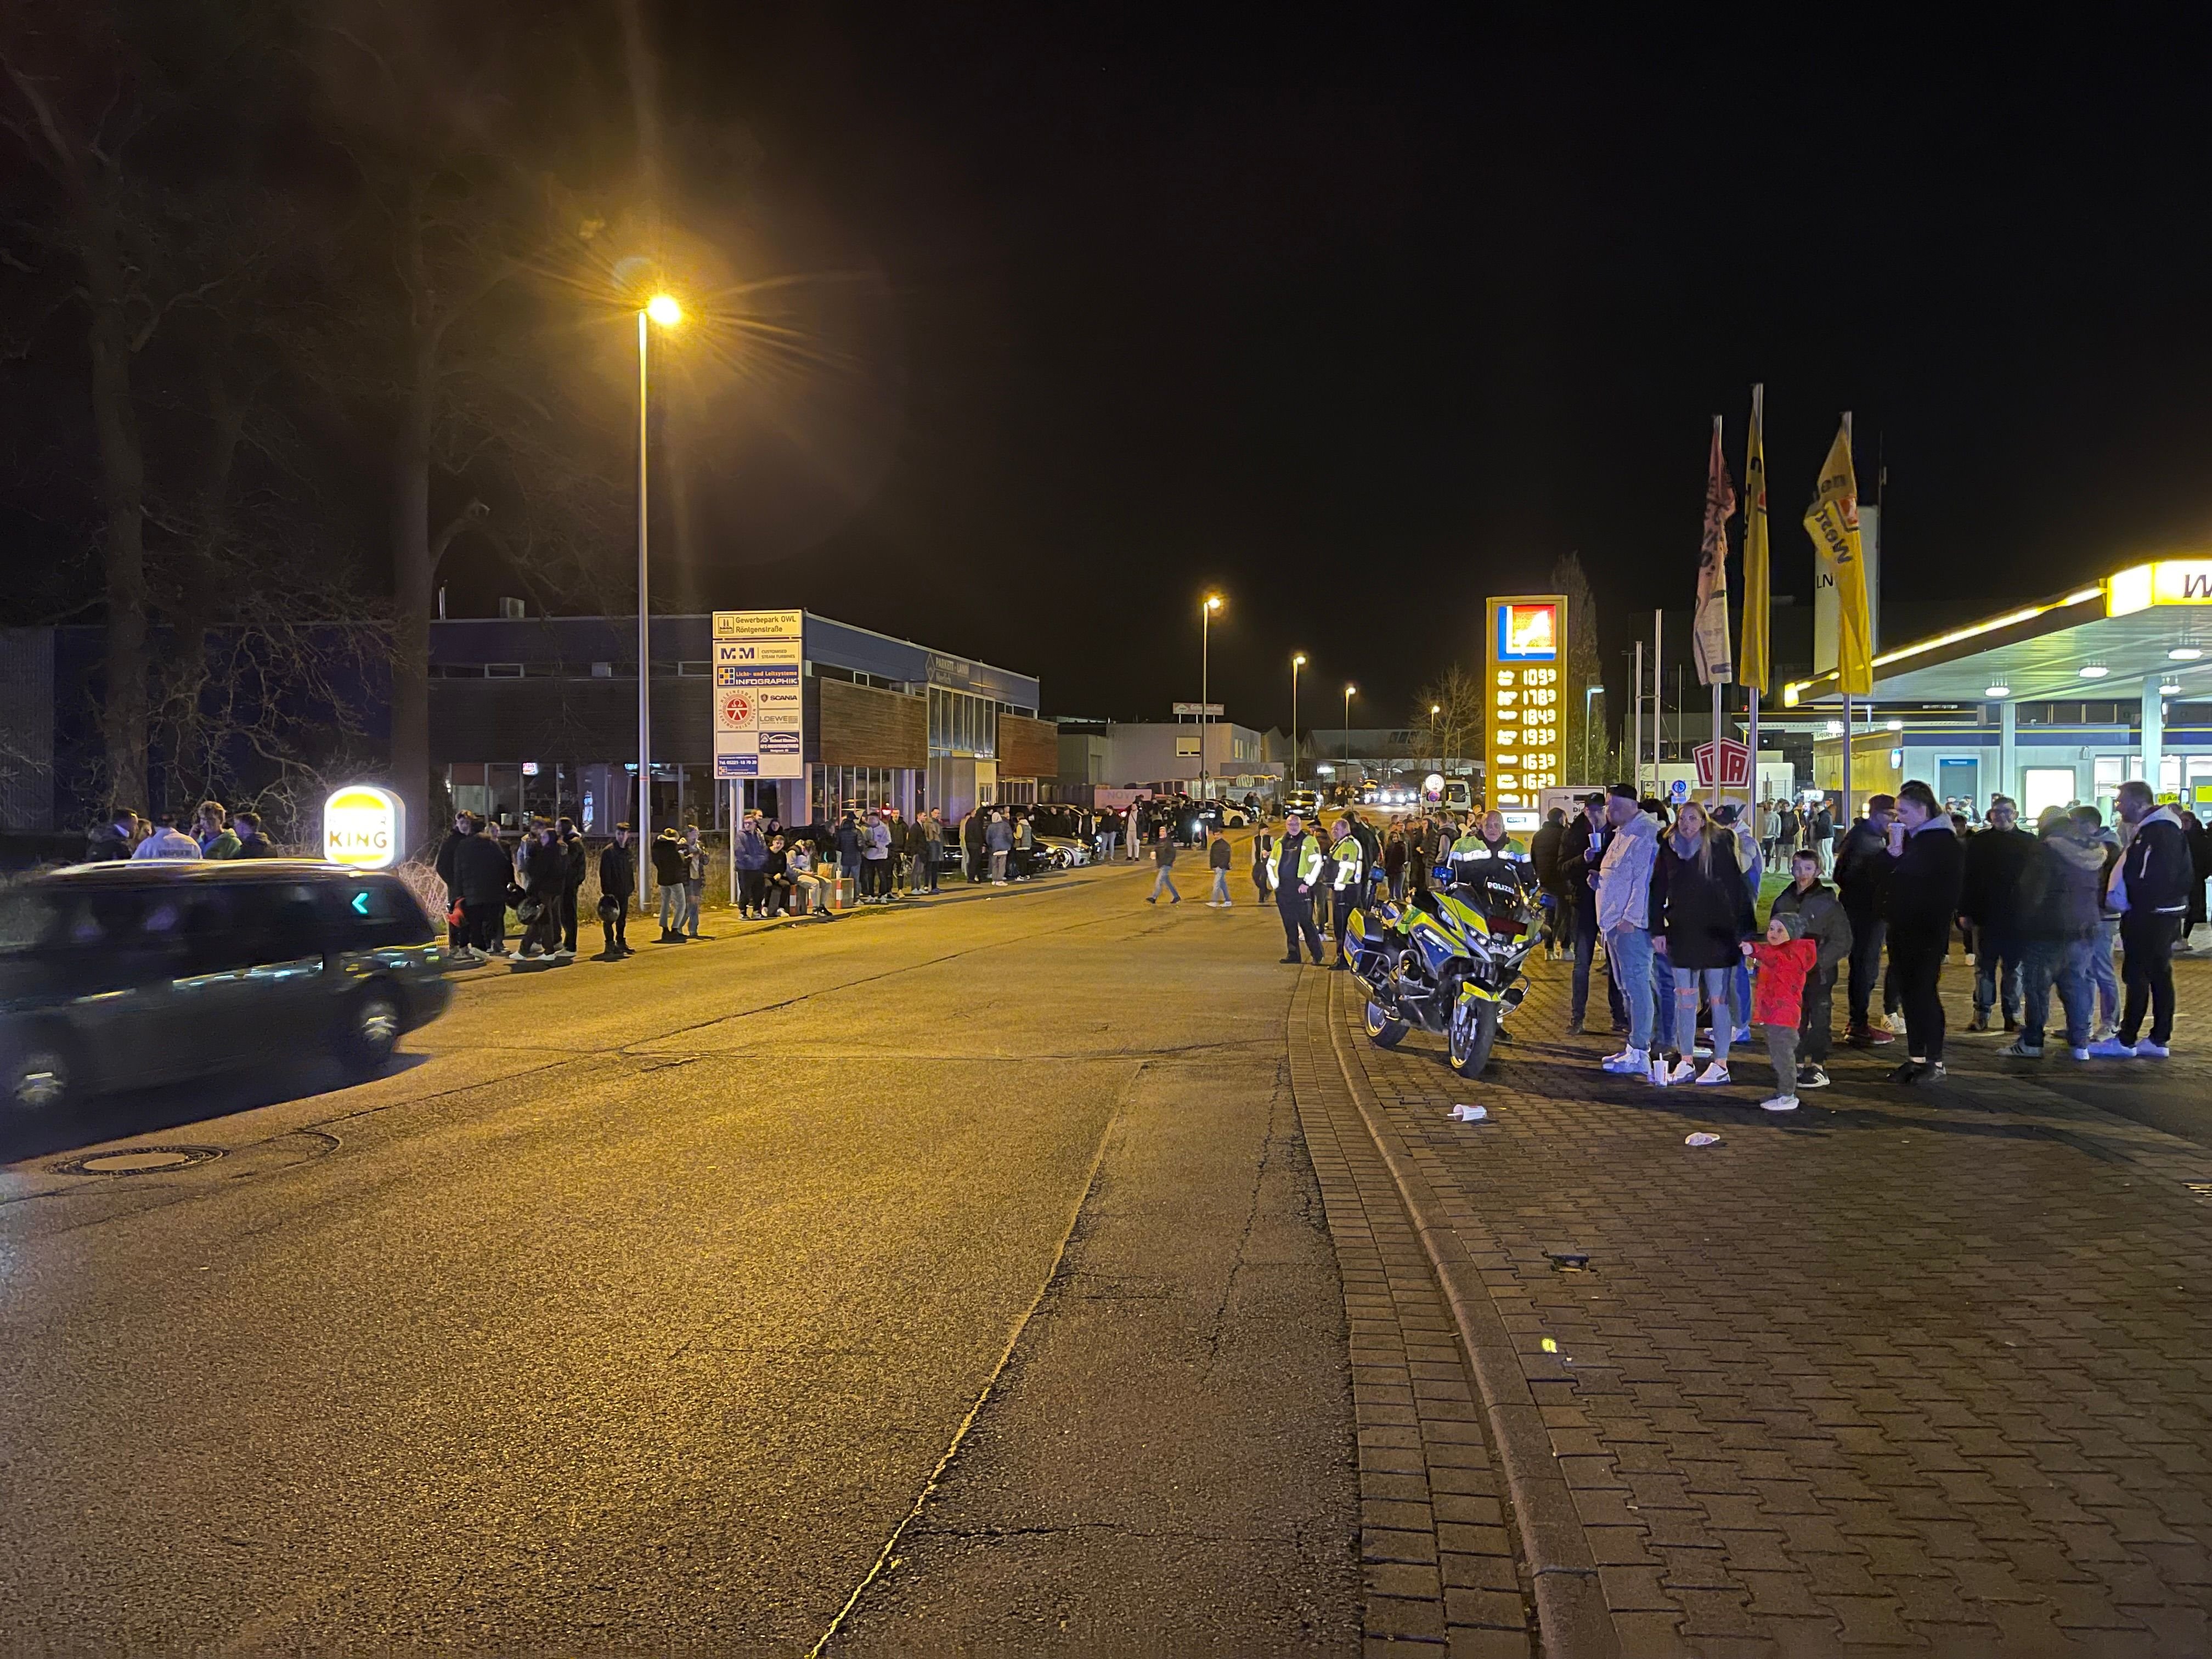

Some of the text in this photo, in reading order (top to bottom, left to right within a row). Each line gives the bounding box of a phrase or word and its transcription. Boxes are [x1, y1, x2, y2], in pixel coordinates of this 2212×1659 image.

[736, 616, 778, 624] Gewerbepark
[736, 625, 782, 634] Röntgenstraße
[329, 830, 387, 849] KING
